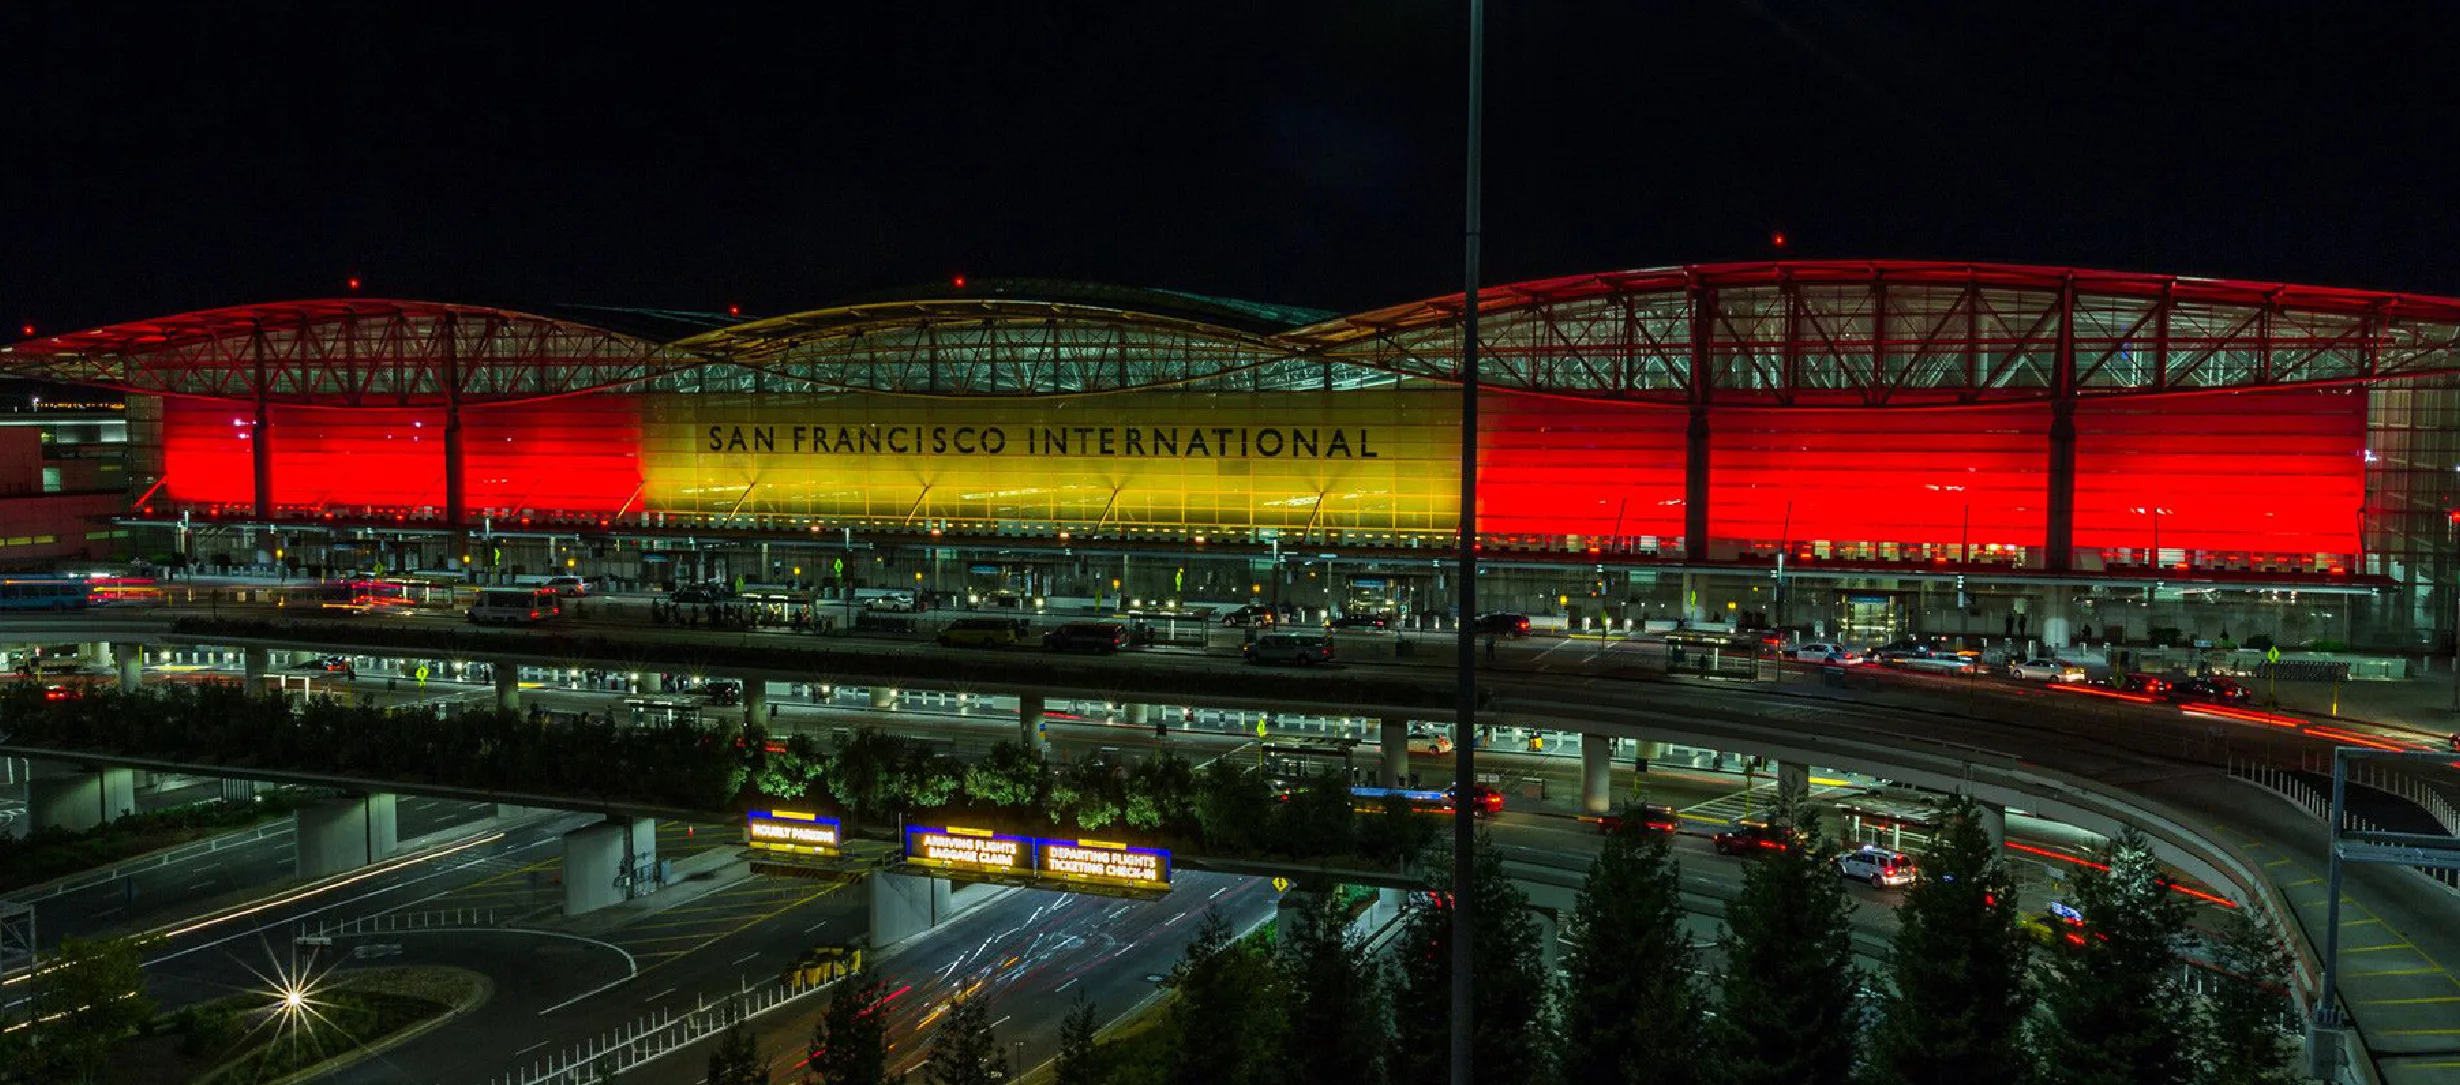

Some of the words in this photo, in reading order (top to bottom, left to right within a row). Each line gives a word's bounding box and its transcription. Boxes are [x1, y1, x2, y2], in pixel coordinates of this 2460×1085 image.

[708, 426, 774, 453] SAN
[793, 426, 1006, 454] FRANCISCO
[1029, 427, 1378, 458] INTERNATIONAL
[923, 834, 974, 850] ARRIVING
[975, 839, 1017, 854] FLIGHTS
[928, 846, 978, 863] BAGGAGE
[978, 852, 1013, 867] CLAIM
[1048, 845, 1110, 863] DEPARTING
[1111, 852, 1156, 868] FLIGHTS
[1048, 858, 1104, 875] TICKETING
[1105, 864, 1156, 881] CHECK-IN
